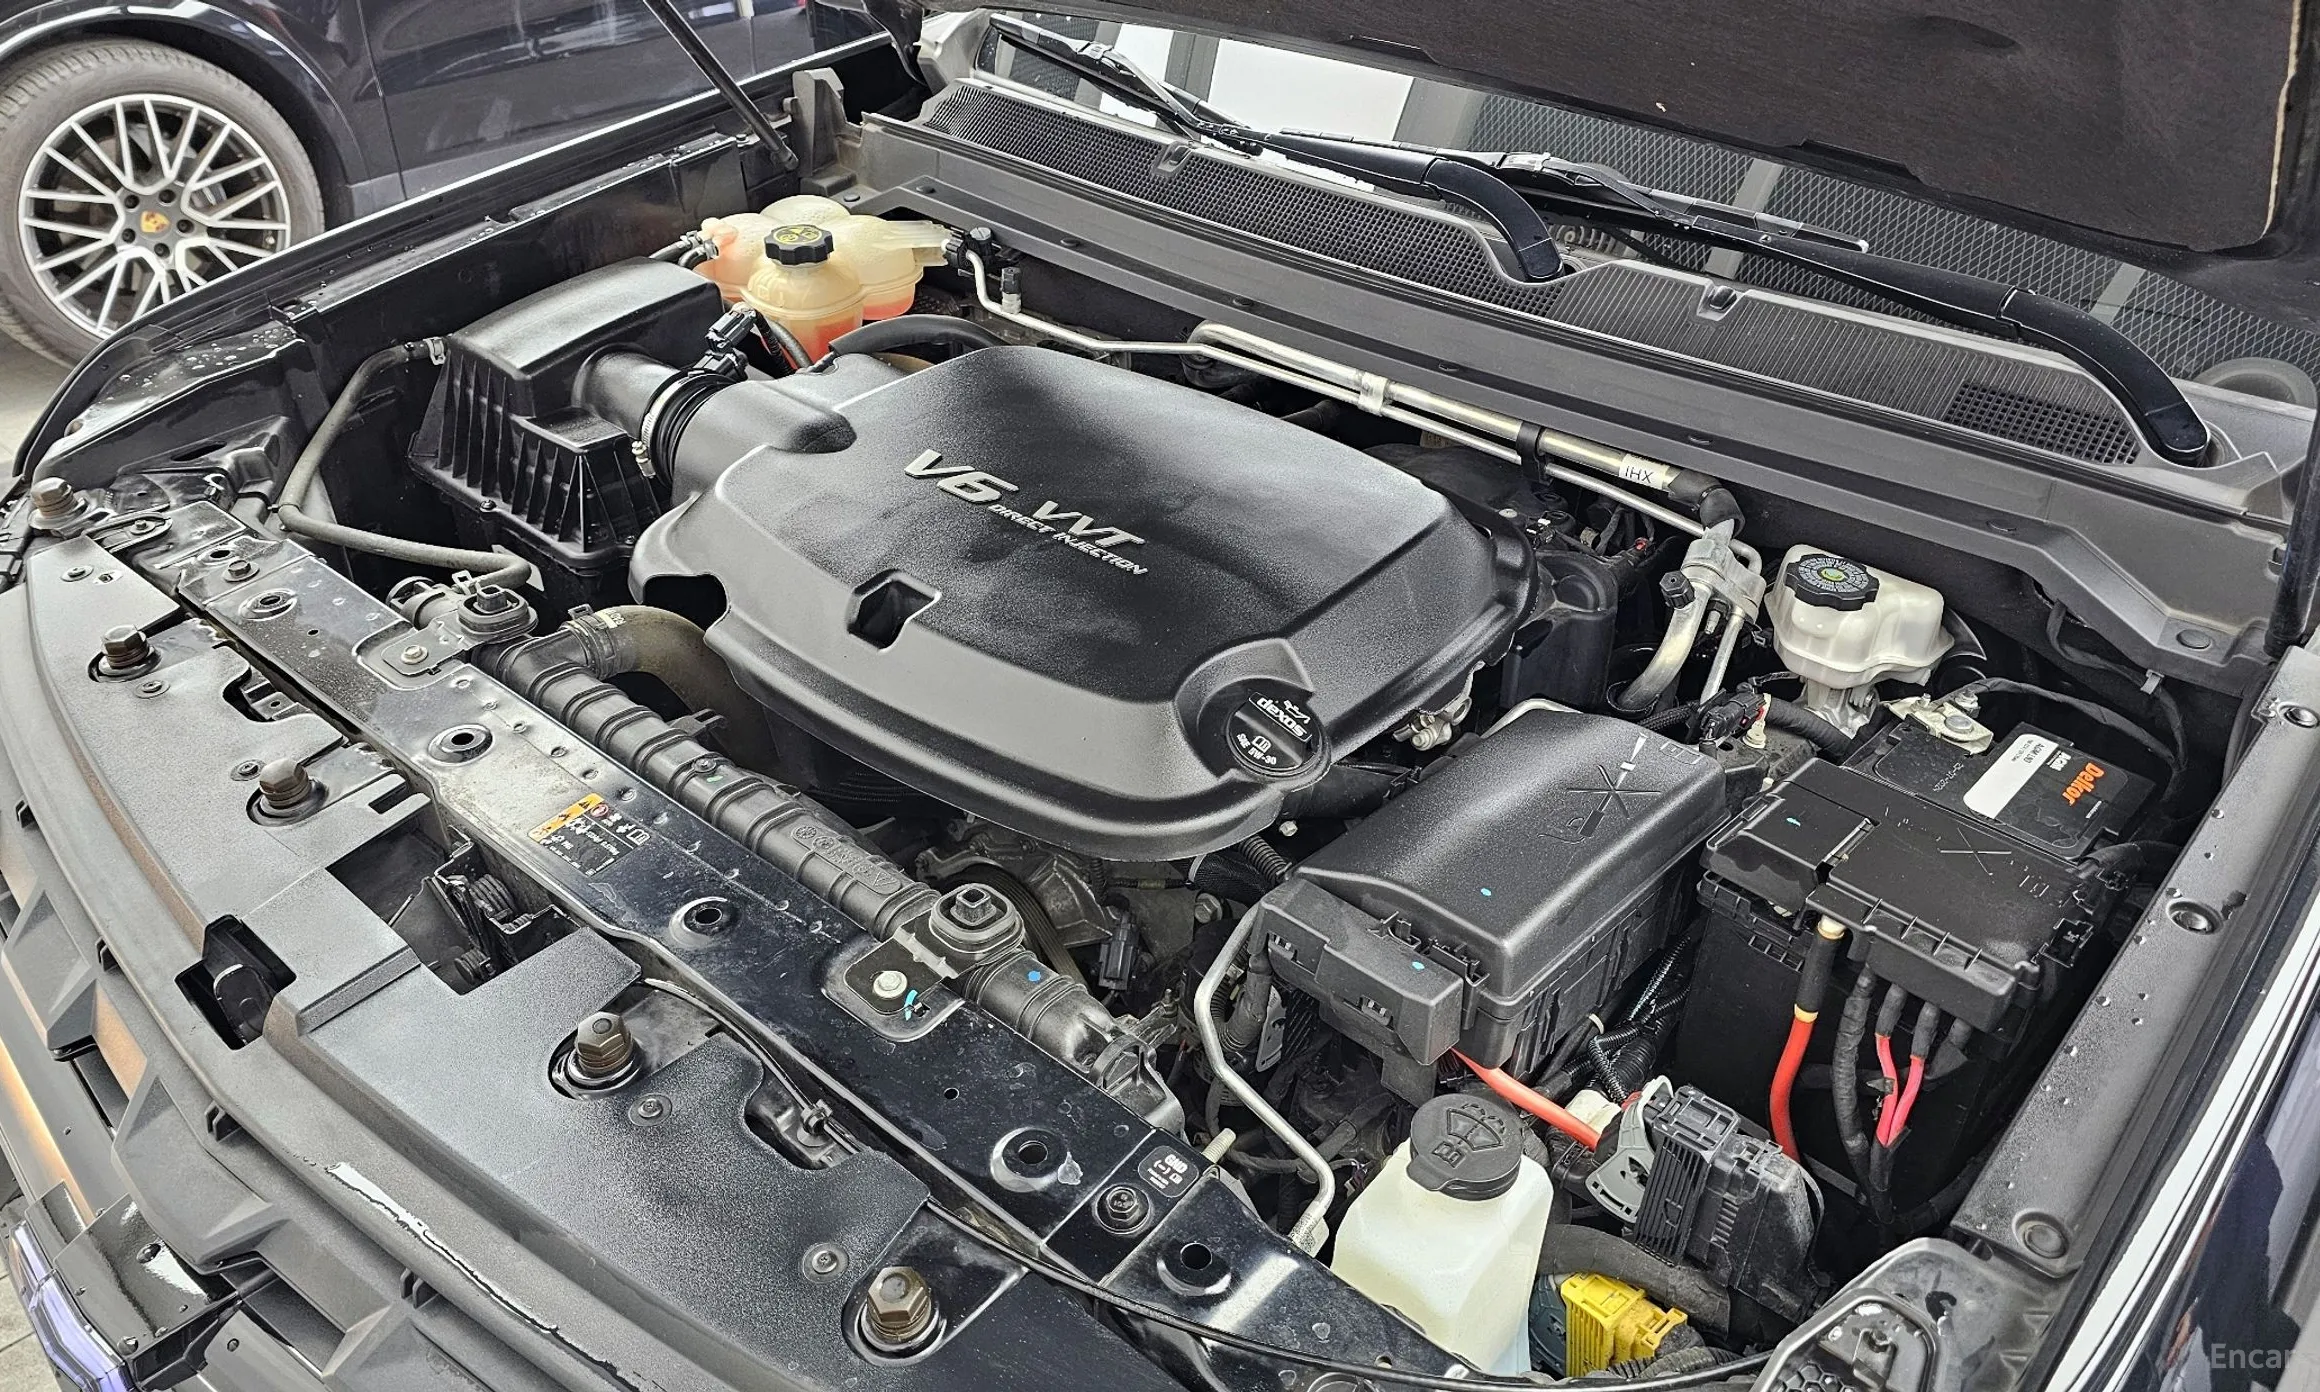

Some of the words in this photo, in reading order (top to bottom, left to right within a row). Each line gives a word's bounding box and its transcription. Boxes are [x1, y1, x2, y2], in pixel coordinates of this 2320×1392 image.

[904, 449, 1019, 503] V6
[1032, 501, 1146, 548] VVT
[988, 504, 1057, 534] DIRECT
[1053, 531, 1149, 575] INJECTION
[1256, 697, 1308, 737] dexos
[2062, 762, 2105, 806] Delkor
[1164, 1153, 1188, 1174] GND
